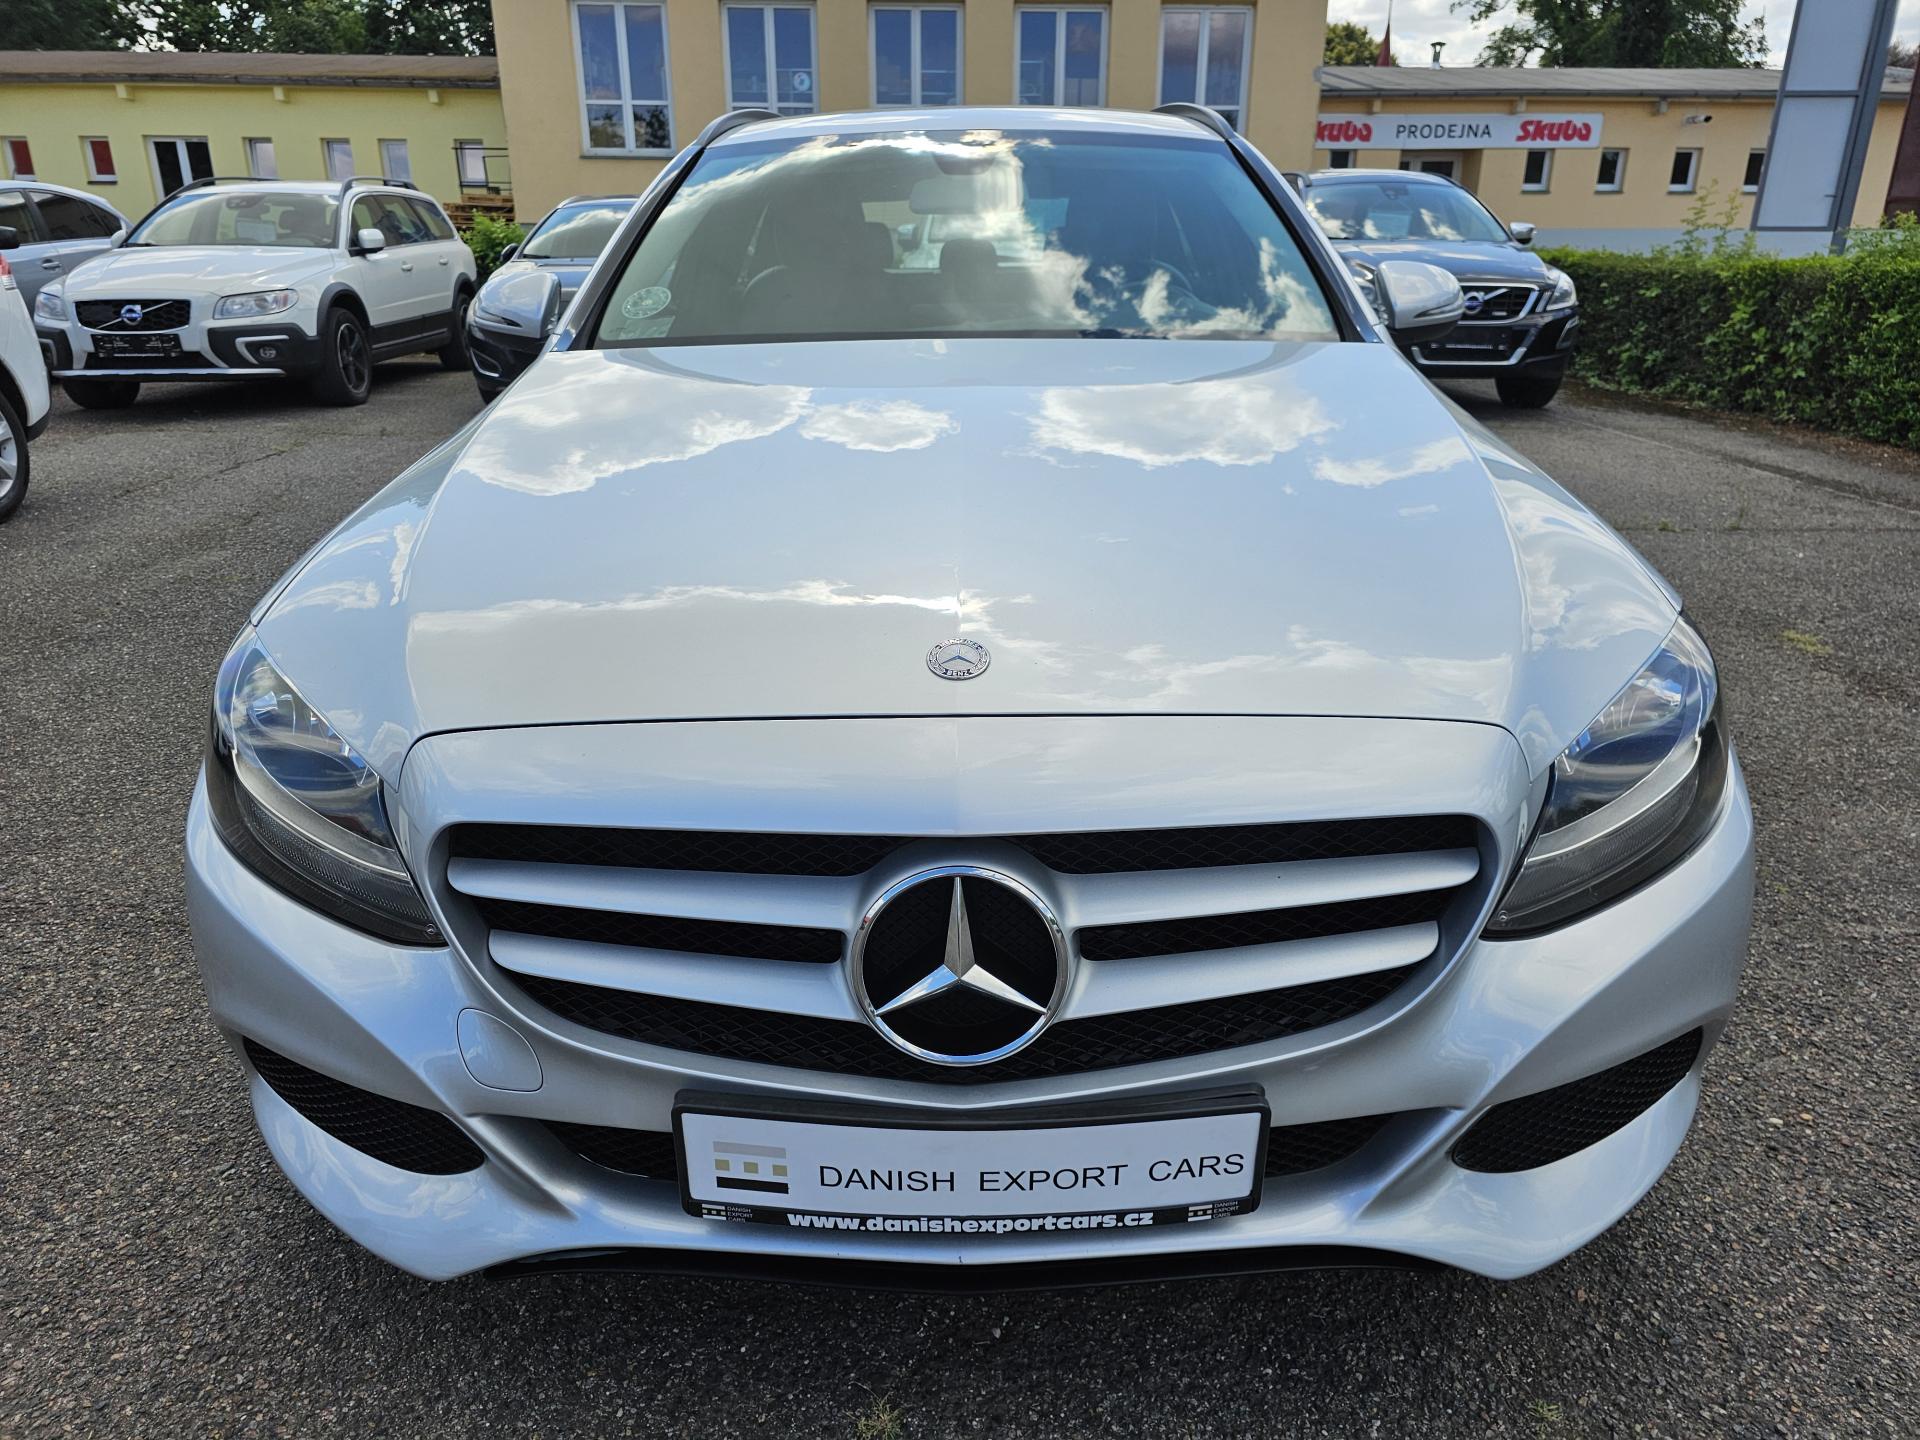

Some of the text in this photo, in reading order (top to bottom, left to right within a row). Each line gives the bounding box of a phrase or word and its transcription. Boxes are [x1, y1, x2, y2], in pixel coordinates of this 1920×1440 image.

[1316, 120, 1592, 142] kuba PRODEJNA Skuba
[819, 1153, 1244, 1193] DANISH EXPORT CARS
[727, 1211, 753, 1219] EXPORT
[787, 1212, 1154, 1234] www.danishexportcars.cz
